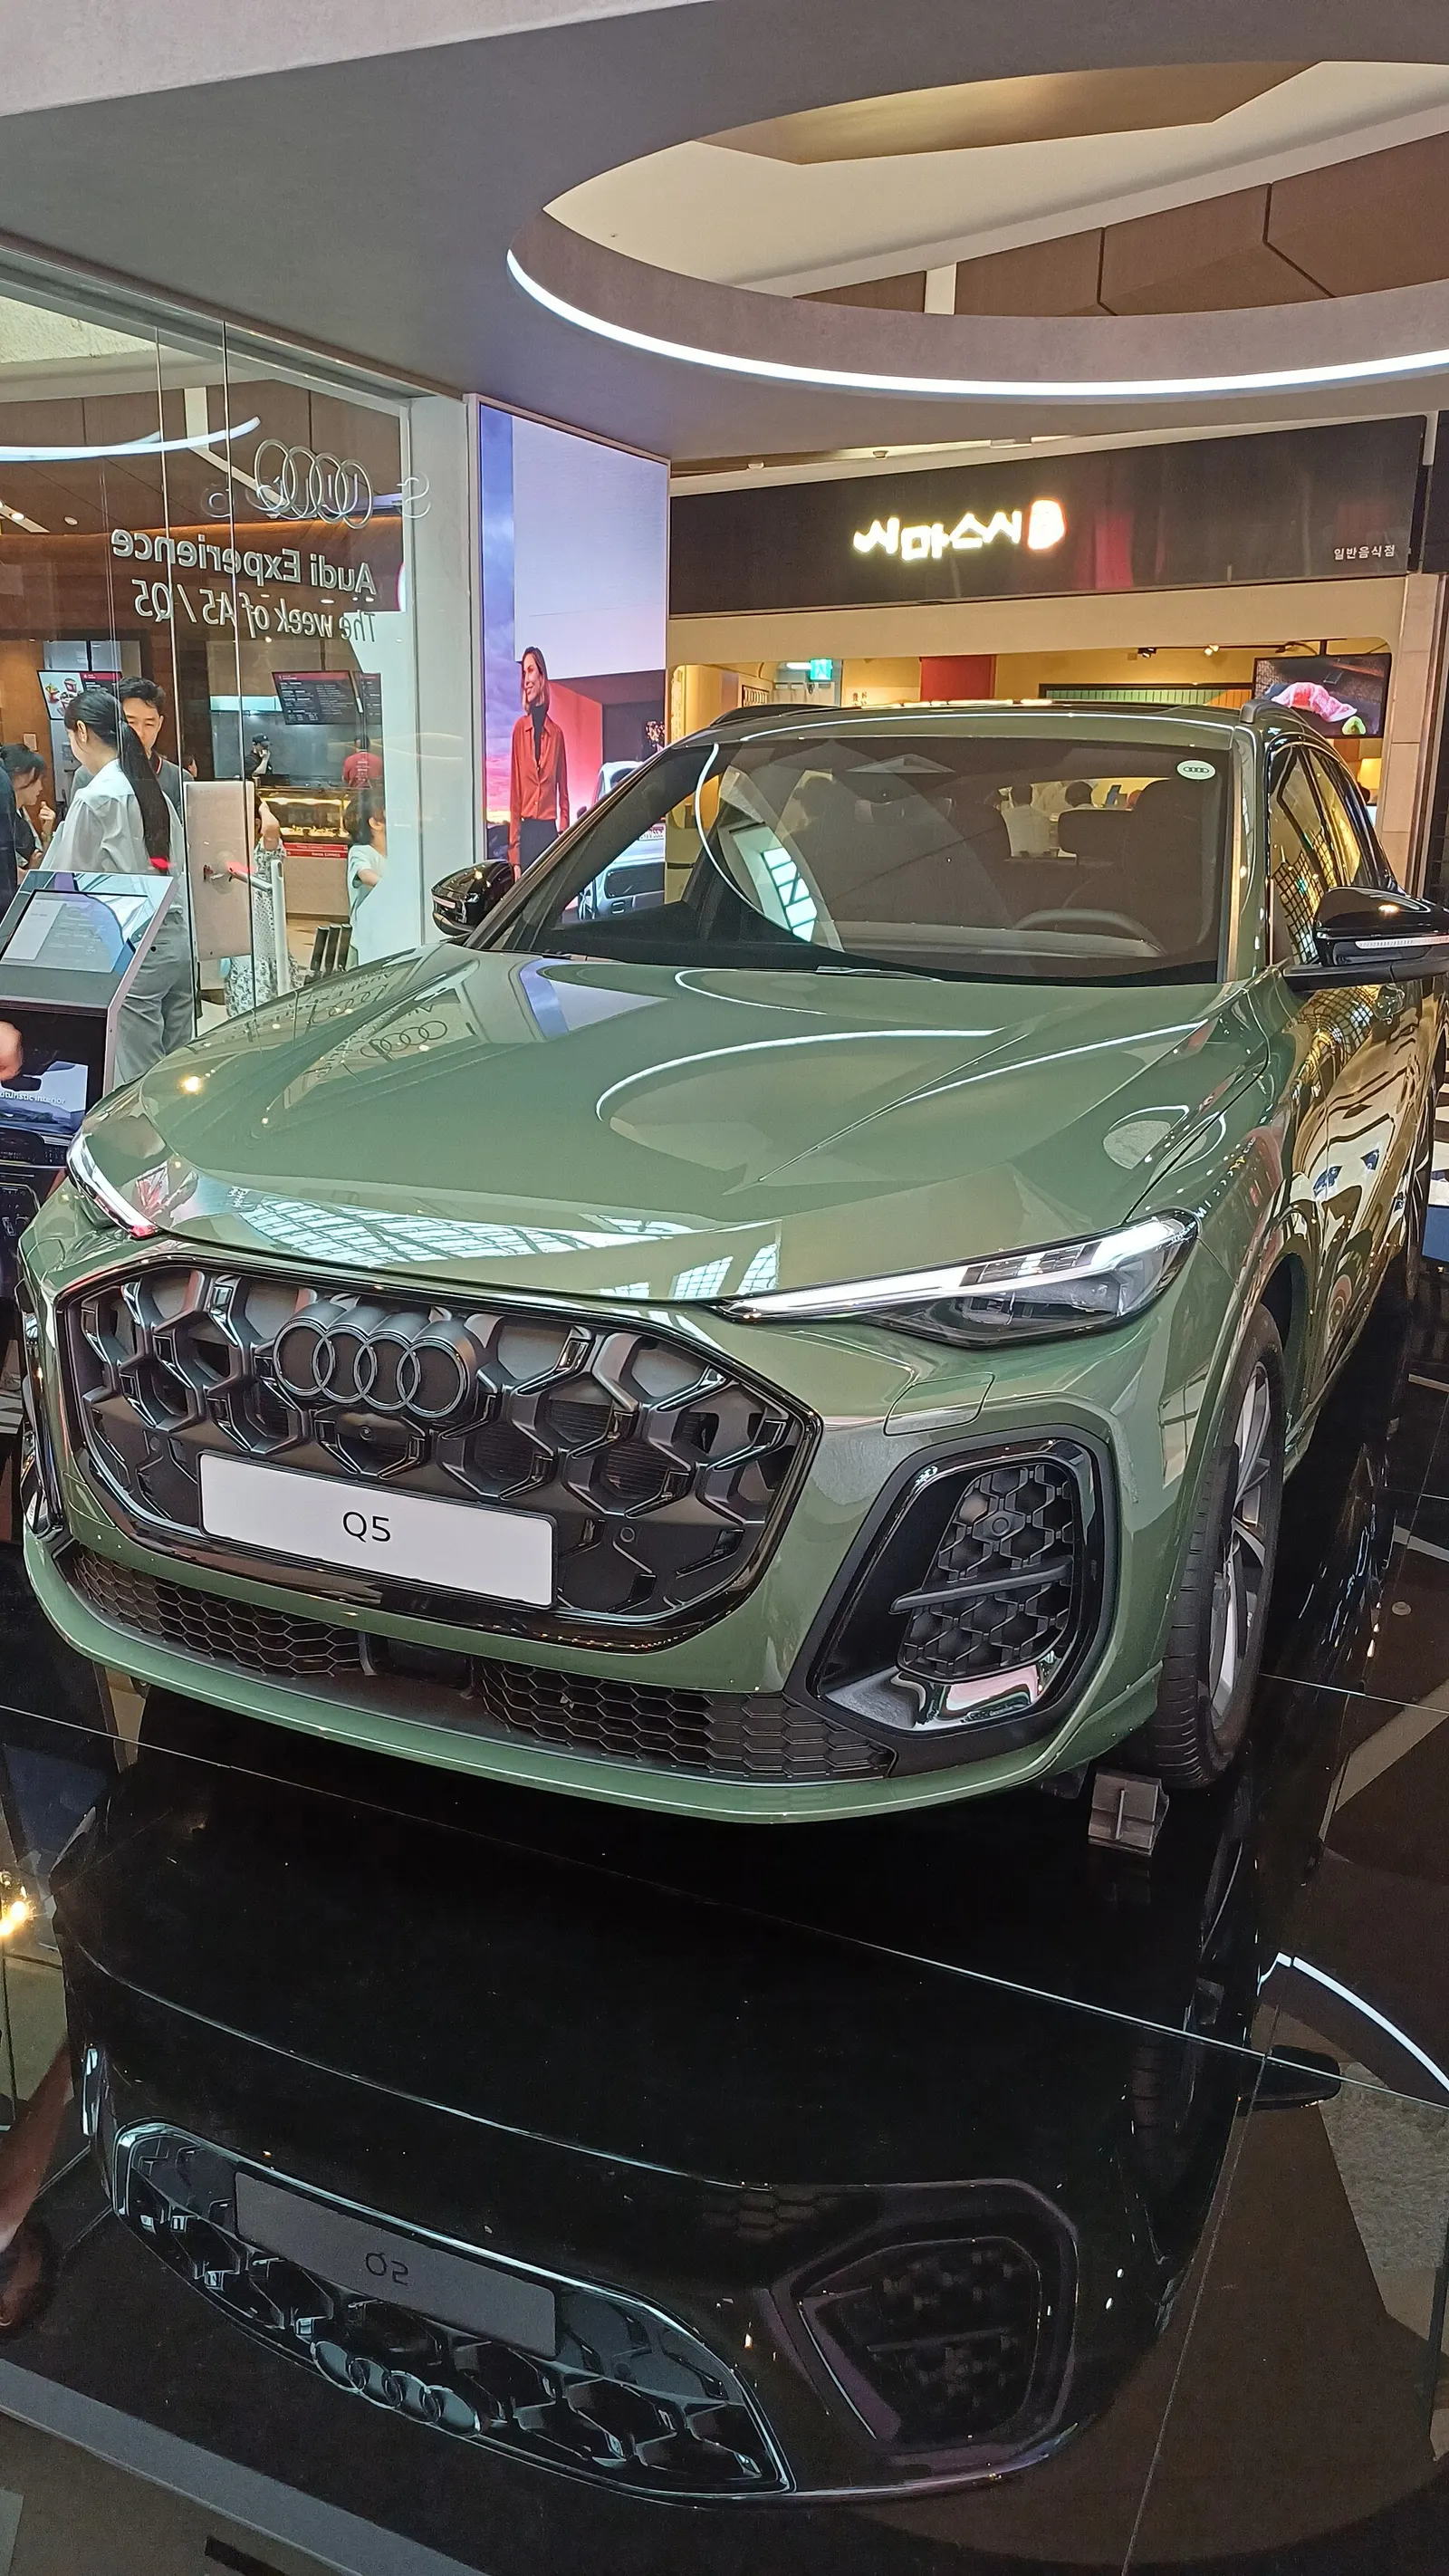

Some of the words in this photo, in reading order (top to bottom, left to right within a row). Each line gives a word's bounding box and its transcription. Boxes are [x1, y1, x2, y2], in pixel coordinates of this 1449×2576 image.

[852, 510, 1022, 562] 시마스시
[1333, 544, 1396, 561] 일반음식점
[342, 1511, 391, 1543] Q5
